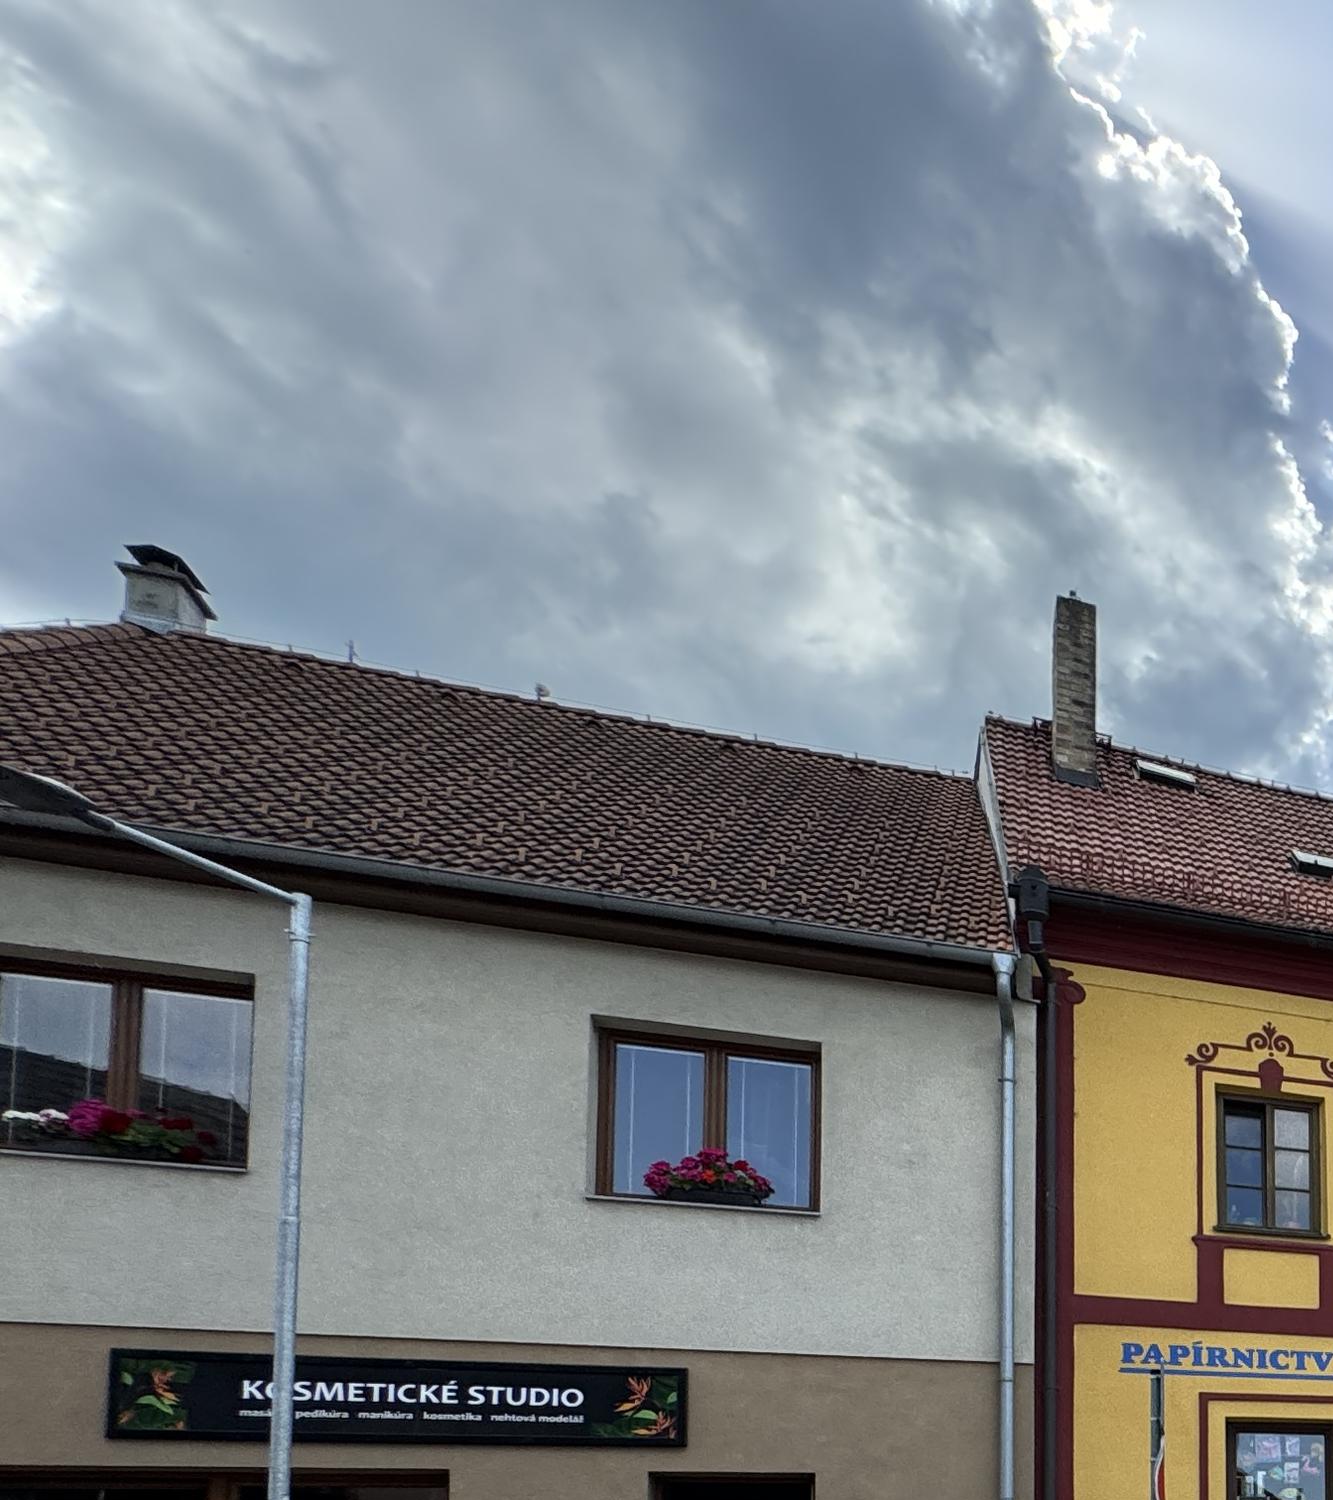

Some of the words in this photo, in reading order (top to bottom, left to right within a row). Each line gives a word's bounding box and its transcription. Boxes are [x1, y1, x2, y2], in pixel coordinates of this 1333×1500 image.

[467, 1385, 584, 1407] STUDIO
[295, 1409, 349, 1419] pedikúra
[358, 1411, 414, 1420] manikúra
[423, 1411, 482, 1421] kosmetika
[490, 1412, 536, 1422] nehtová
